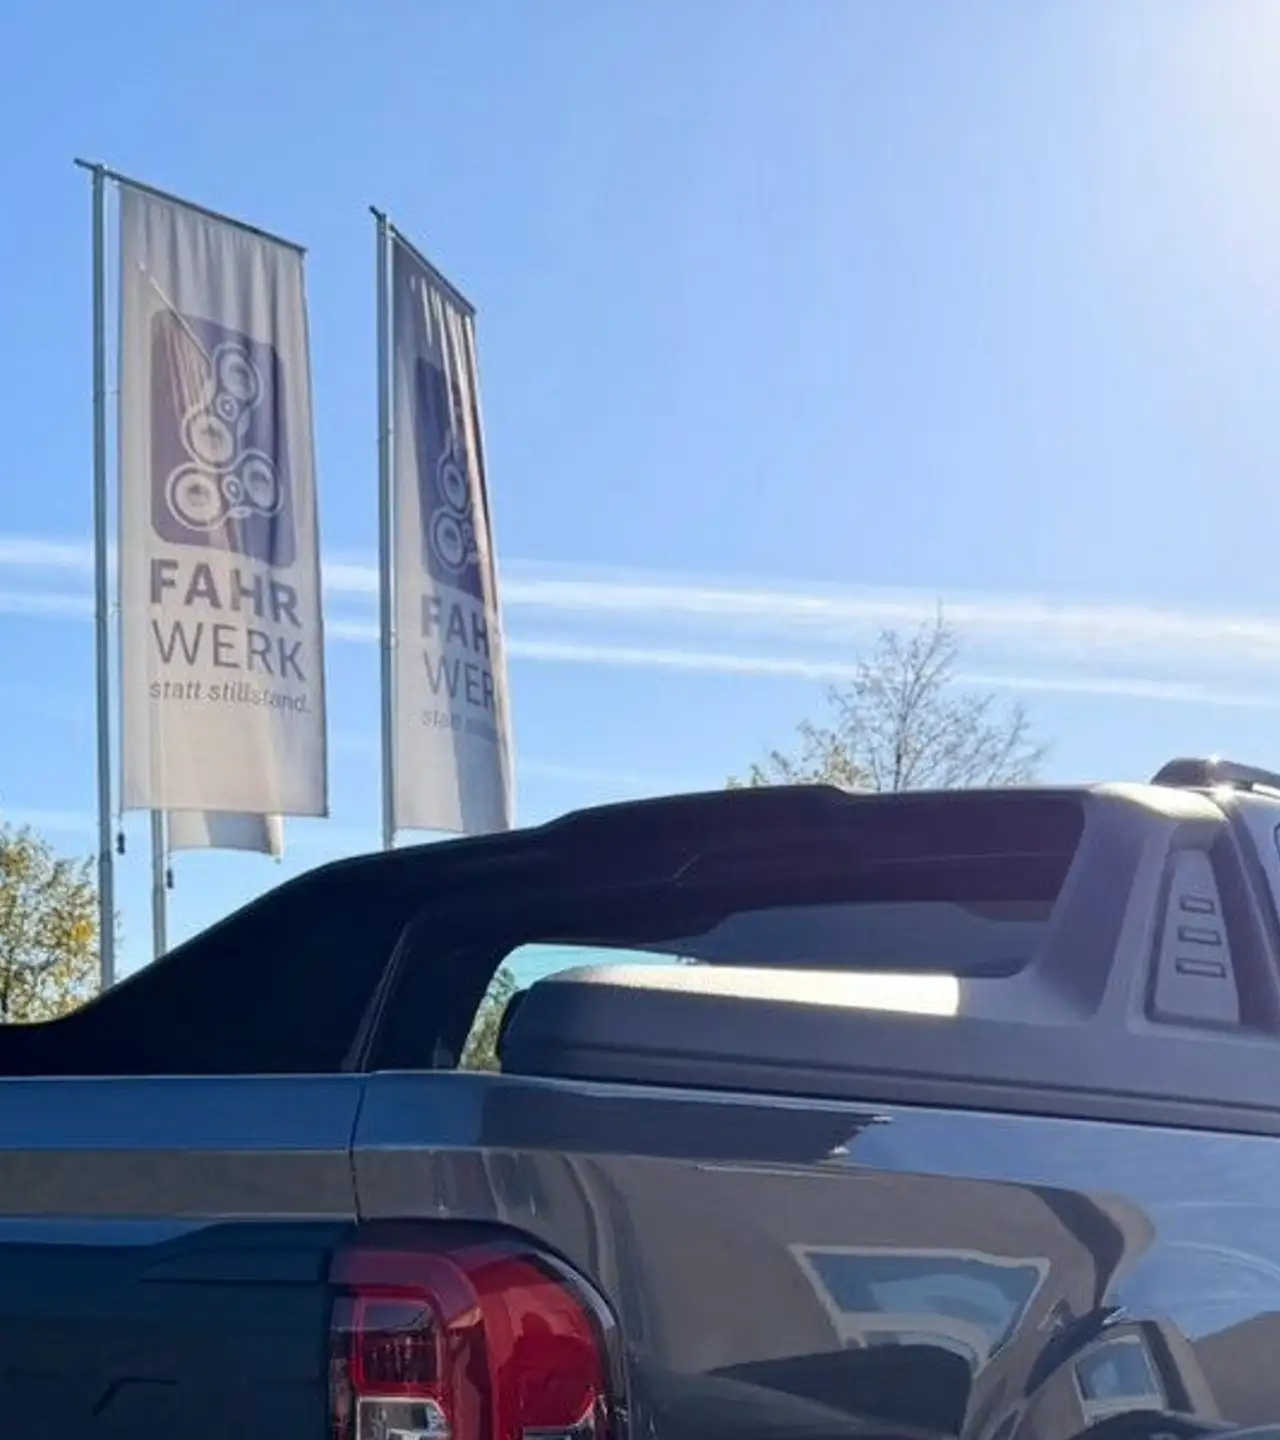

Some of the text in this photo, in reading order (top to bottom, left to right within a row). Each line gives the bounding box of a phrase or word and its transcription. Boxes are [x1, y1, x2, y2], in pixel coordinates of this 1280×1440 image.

[149, 558, 302, 628] FAHR
[152, 618, 307, 683] WERK
[421, 594, 490, 660] FAH
[149, 679, 202, 701] statt
